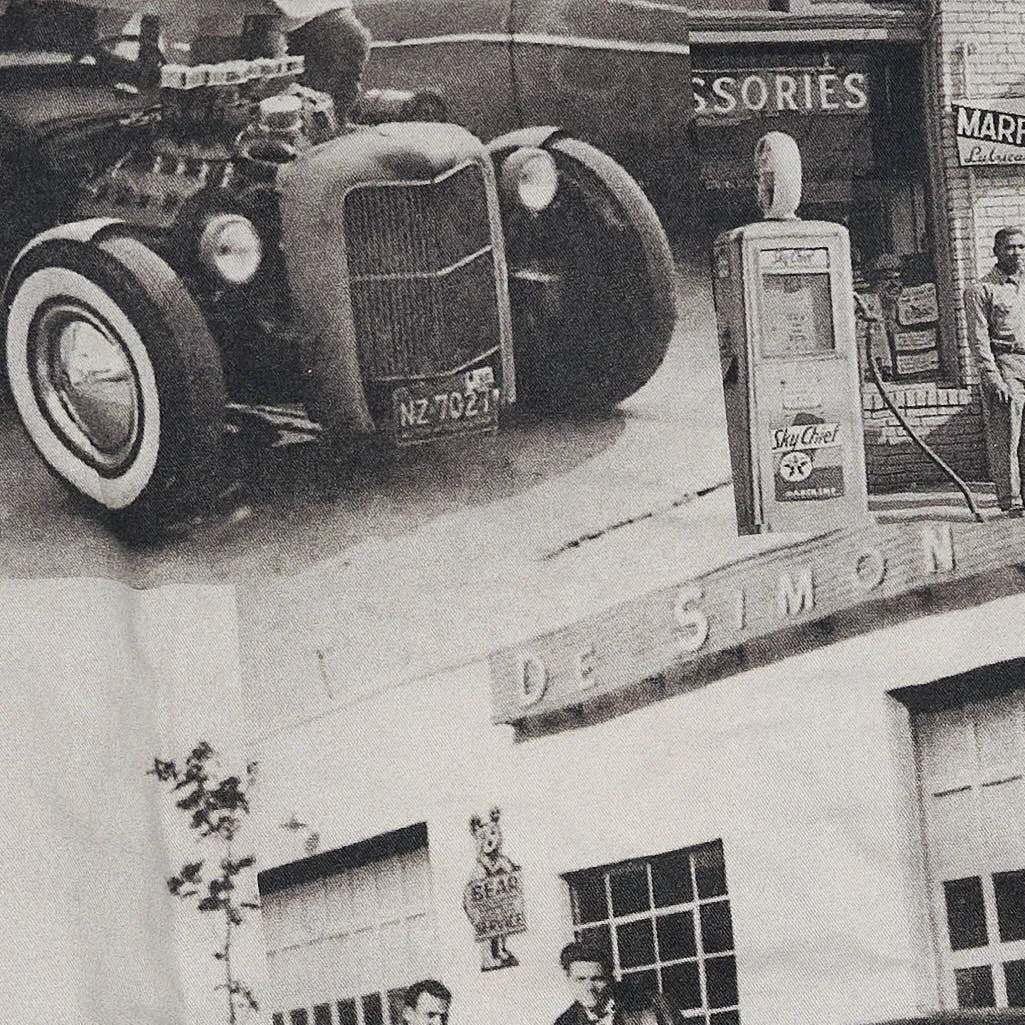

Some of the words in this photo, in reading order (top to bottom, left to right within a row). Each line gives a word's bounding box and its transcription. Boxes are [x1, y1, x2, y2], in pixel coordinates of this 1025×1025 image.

[772, 425, 799, 450] Sky
[801, 424, 839, 445] Chief
[472, 876, 519, 901] BEAR
